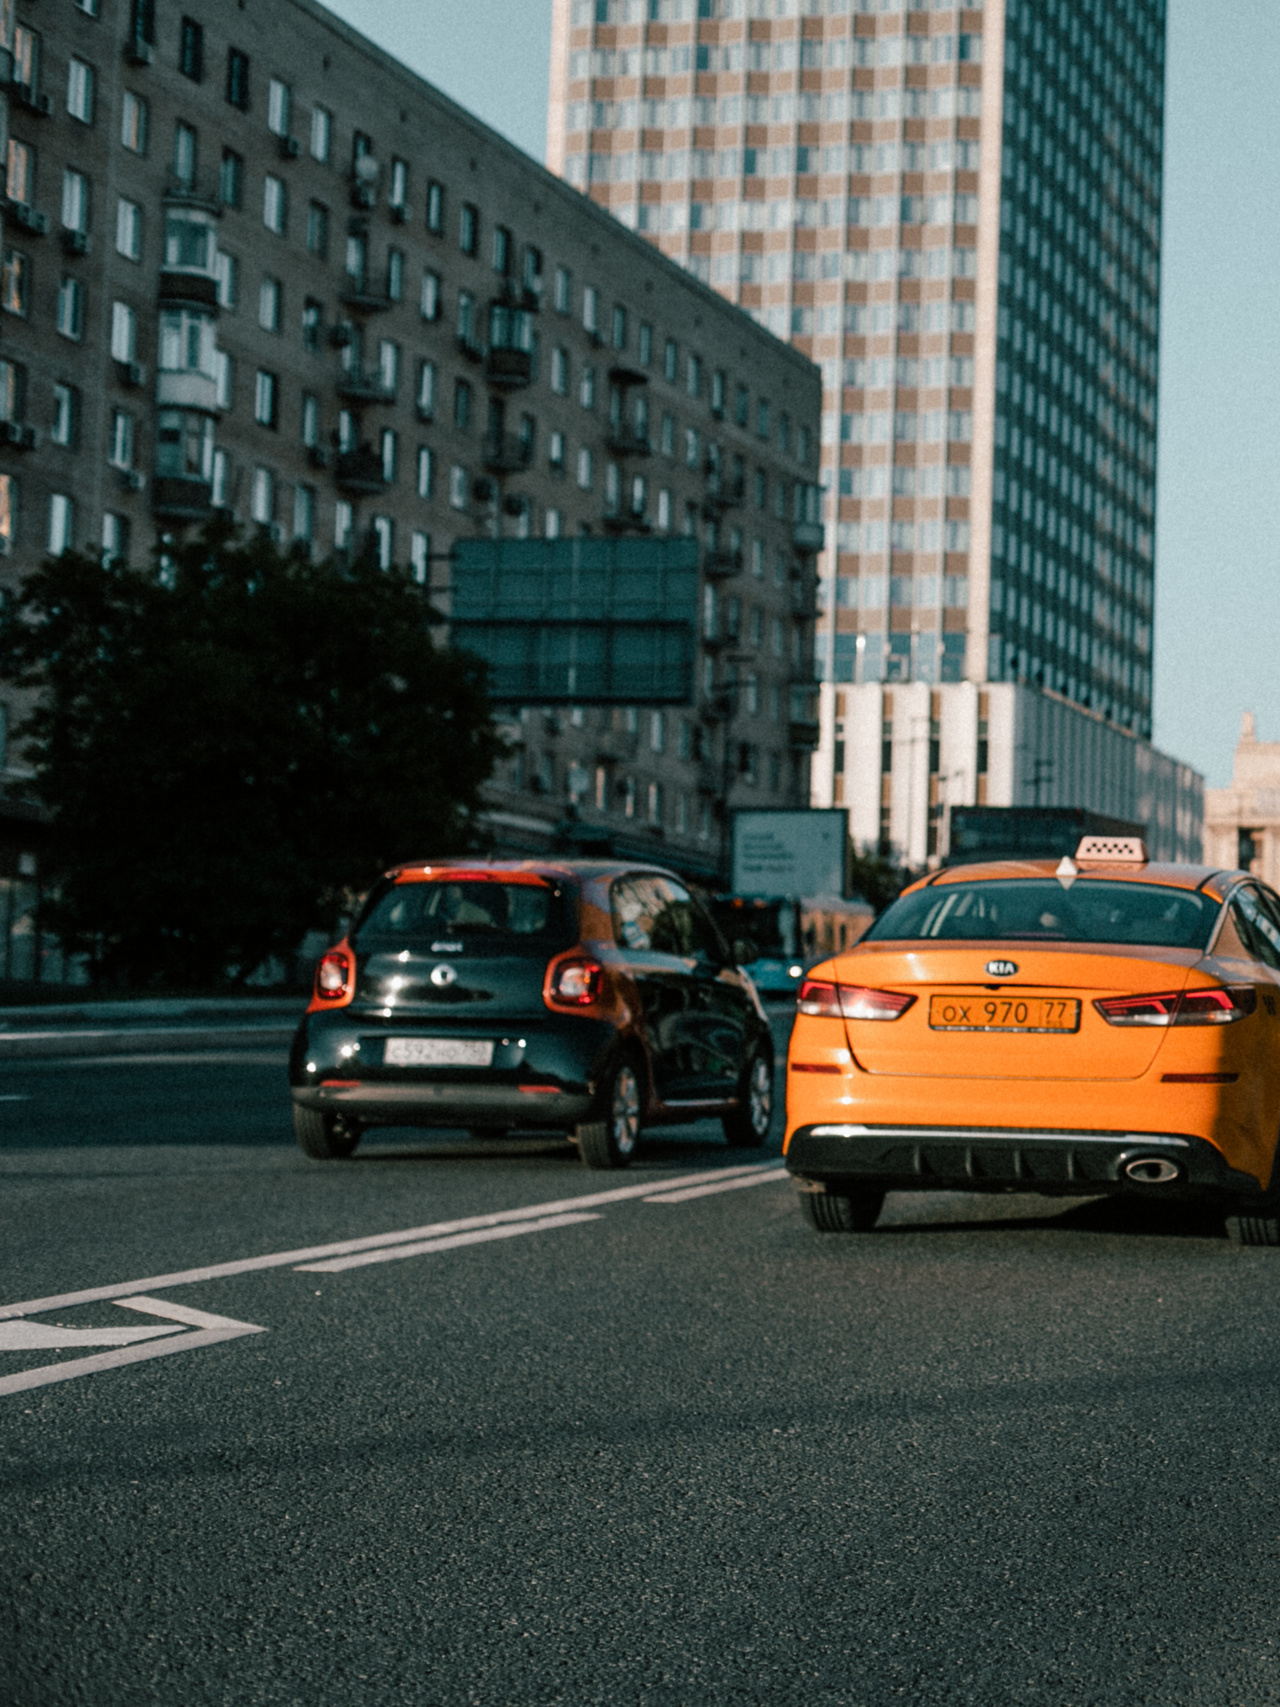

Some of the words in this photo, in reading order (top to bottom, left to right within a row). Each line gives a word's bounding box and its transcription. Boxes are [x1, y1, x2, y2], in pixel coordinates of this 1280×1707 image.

[988, 961, 1015, 974] KIA
[984, 1002, 1028, 1024] 970
[1044, 1002, 1067, 1019] 77
